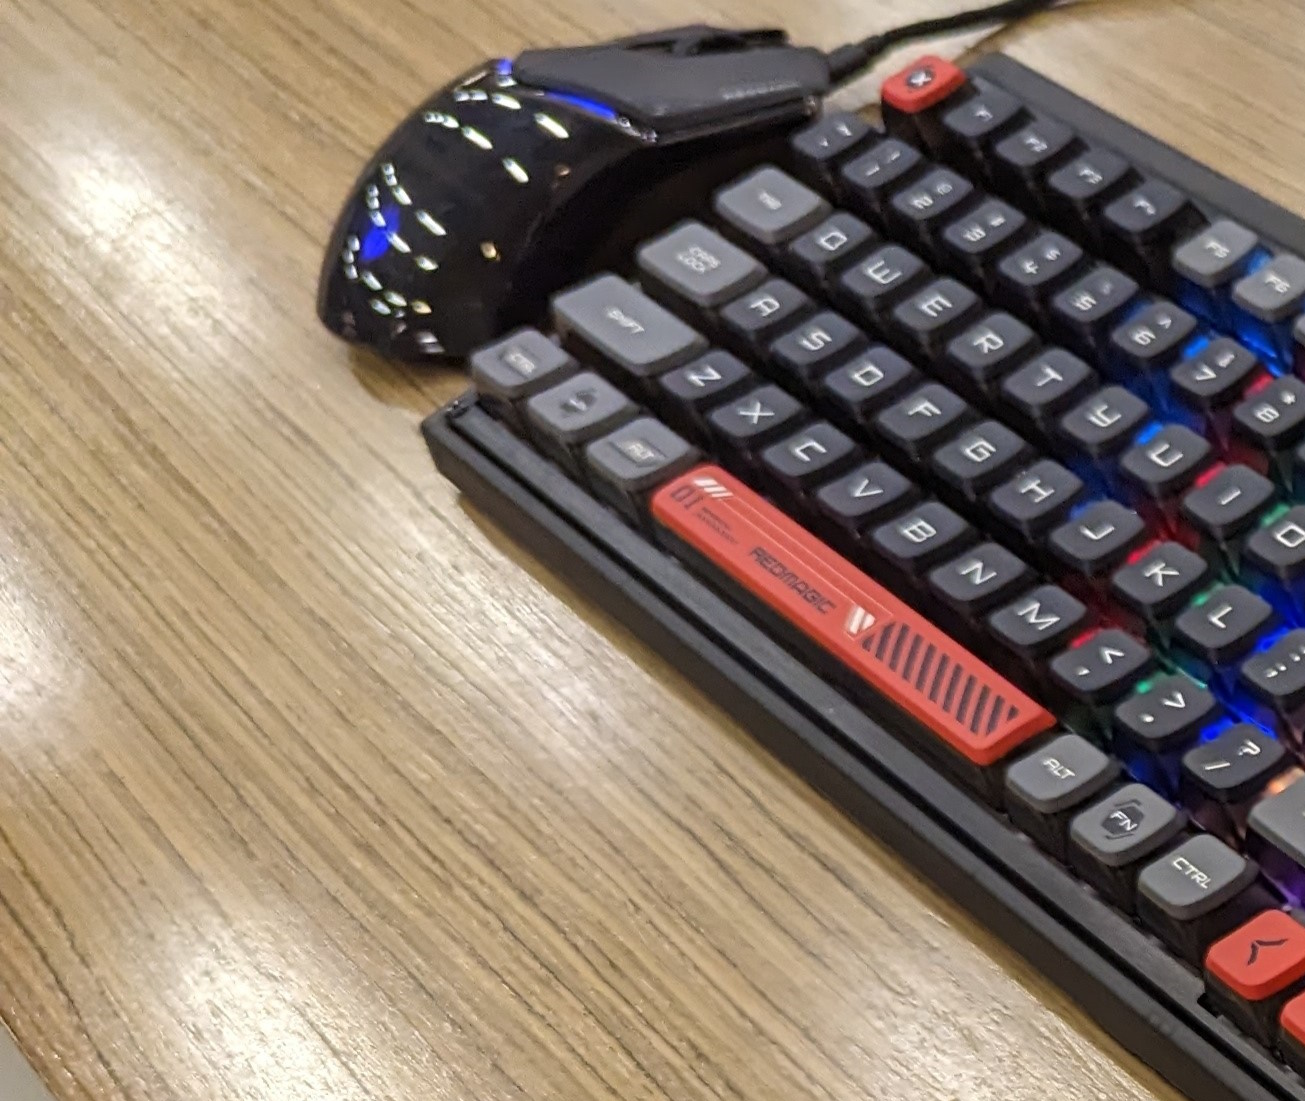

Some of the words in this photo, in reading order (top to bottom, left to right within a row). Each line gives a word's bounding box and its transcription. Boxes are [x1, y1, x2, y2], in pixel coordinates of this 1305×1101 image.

[910, 195, 933, 209] 2
[1022, 258, 1039, 274] 4
[1264, 274, 1292, 294] F6
[750, 295, 780, 320] A
[921, 296, 952, 318] E
[1072, 293, 1097, 311] 5
[801, 327, 832, 350] S
[973, 331, 1004, 353] R
[1132, 327, 1155, 345] 6
[687, 365, 722, 387] Z
[850, 364, 884, 386] D
[1037, 365, 1063, 386] T
[1196, 365, 1216, 381] 7
[738, 402, 775, 424] X
[908, 400, 941, 416] F
[1255, 405, 1279, 423] 8
[792, 439, 827, 461] C
[963, 437, 997, 462] G
[1150, 443, 1183, 467] U
[853, 479, 884, 498] V
[1019, 480, 1054, 503] H
[1221, 487, 1241, 505] I
[903, 518, 937, 543] B
[1080, 520, 1115, 540] J
[750, 546, 836, 615] REDMAGIC
[960, 561, 997, 584] N
[1144, 562, 1179, 586] K
[1018, 602, 1060, 630] M
[1208, 605, 1232, 628] L
[1043, 758, 1076, 780] ALT
[1110, 810, 1138, 831] FN
[1172, 856, 1212, 889] CTRL
